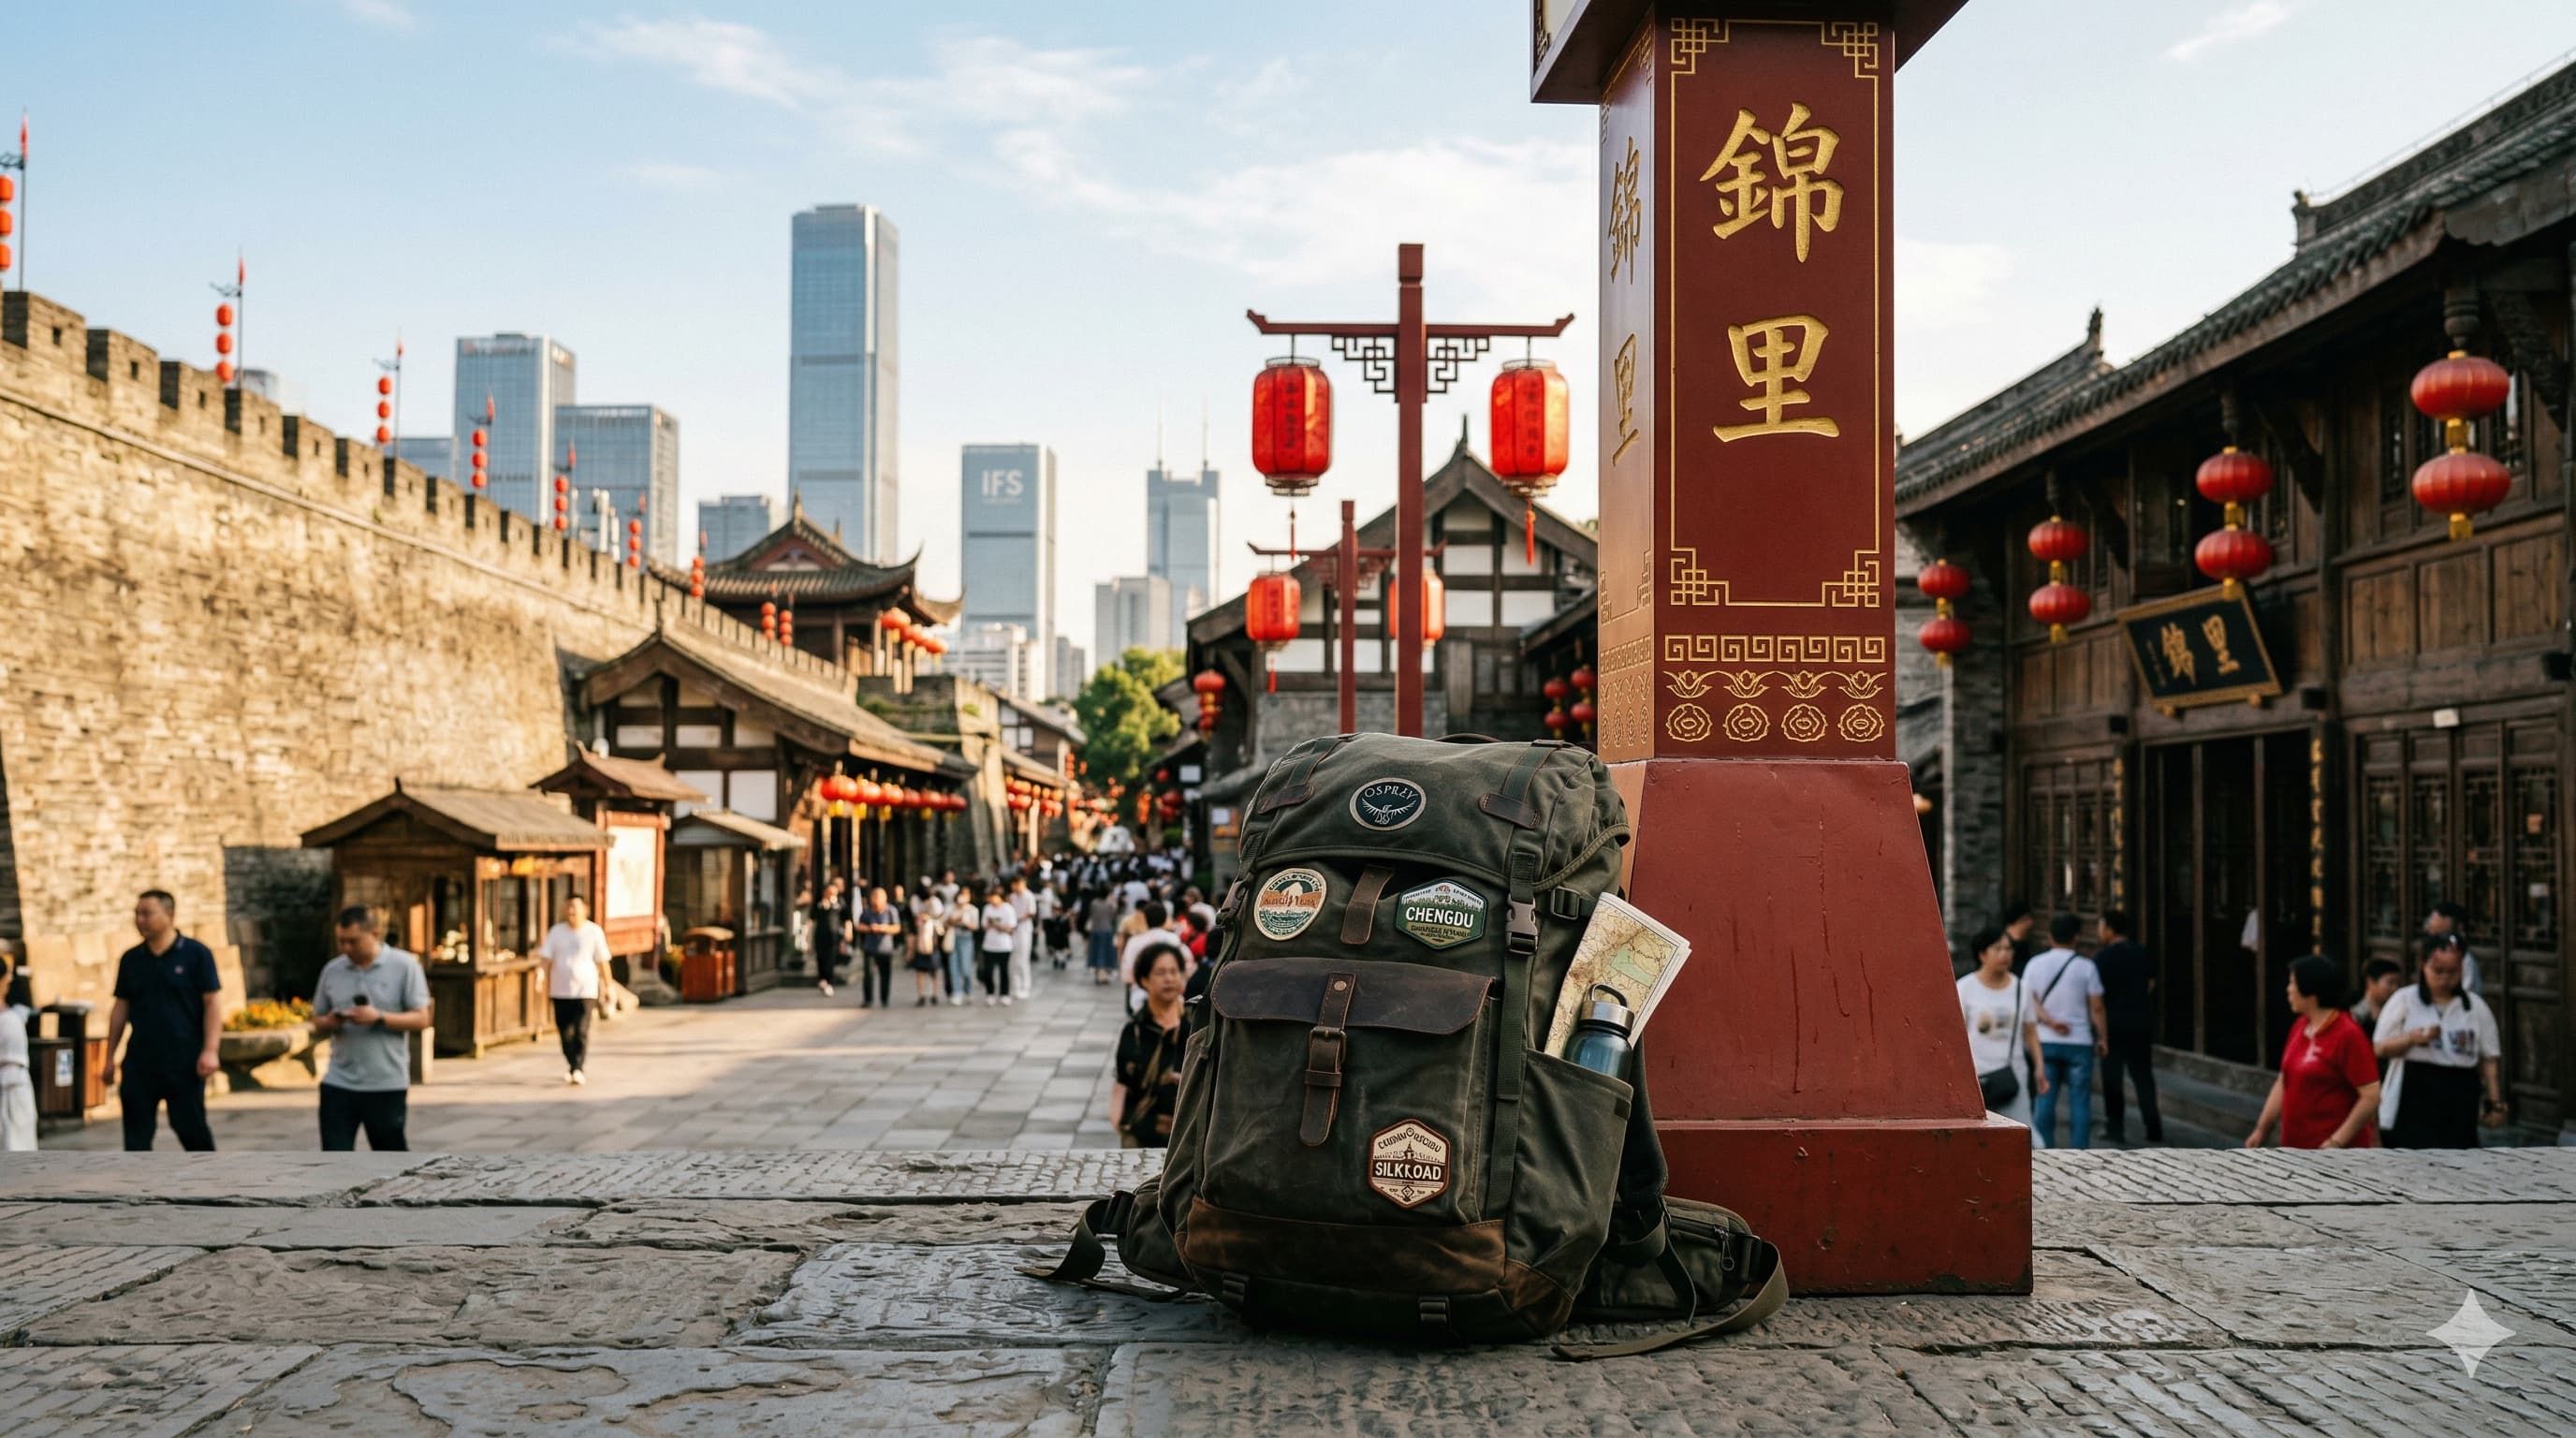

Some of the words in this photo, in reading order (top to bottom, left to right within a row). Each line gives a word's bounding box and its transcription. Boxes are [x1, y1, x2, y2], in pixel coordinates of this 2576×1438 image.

[1699, 100, 1844, 444] 錦里
[1607, 136, 1642, 467] 錦里
[982, 470, 1024, 495] IFS
[1364, 785, 1419, 800] OSPREY
[1405, 906, 1474, 929] CHENGDU
